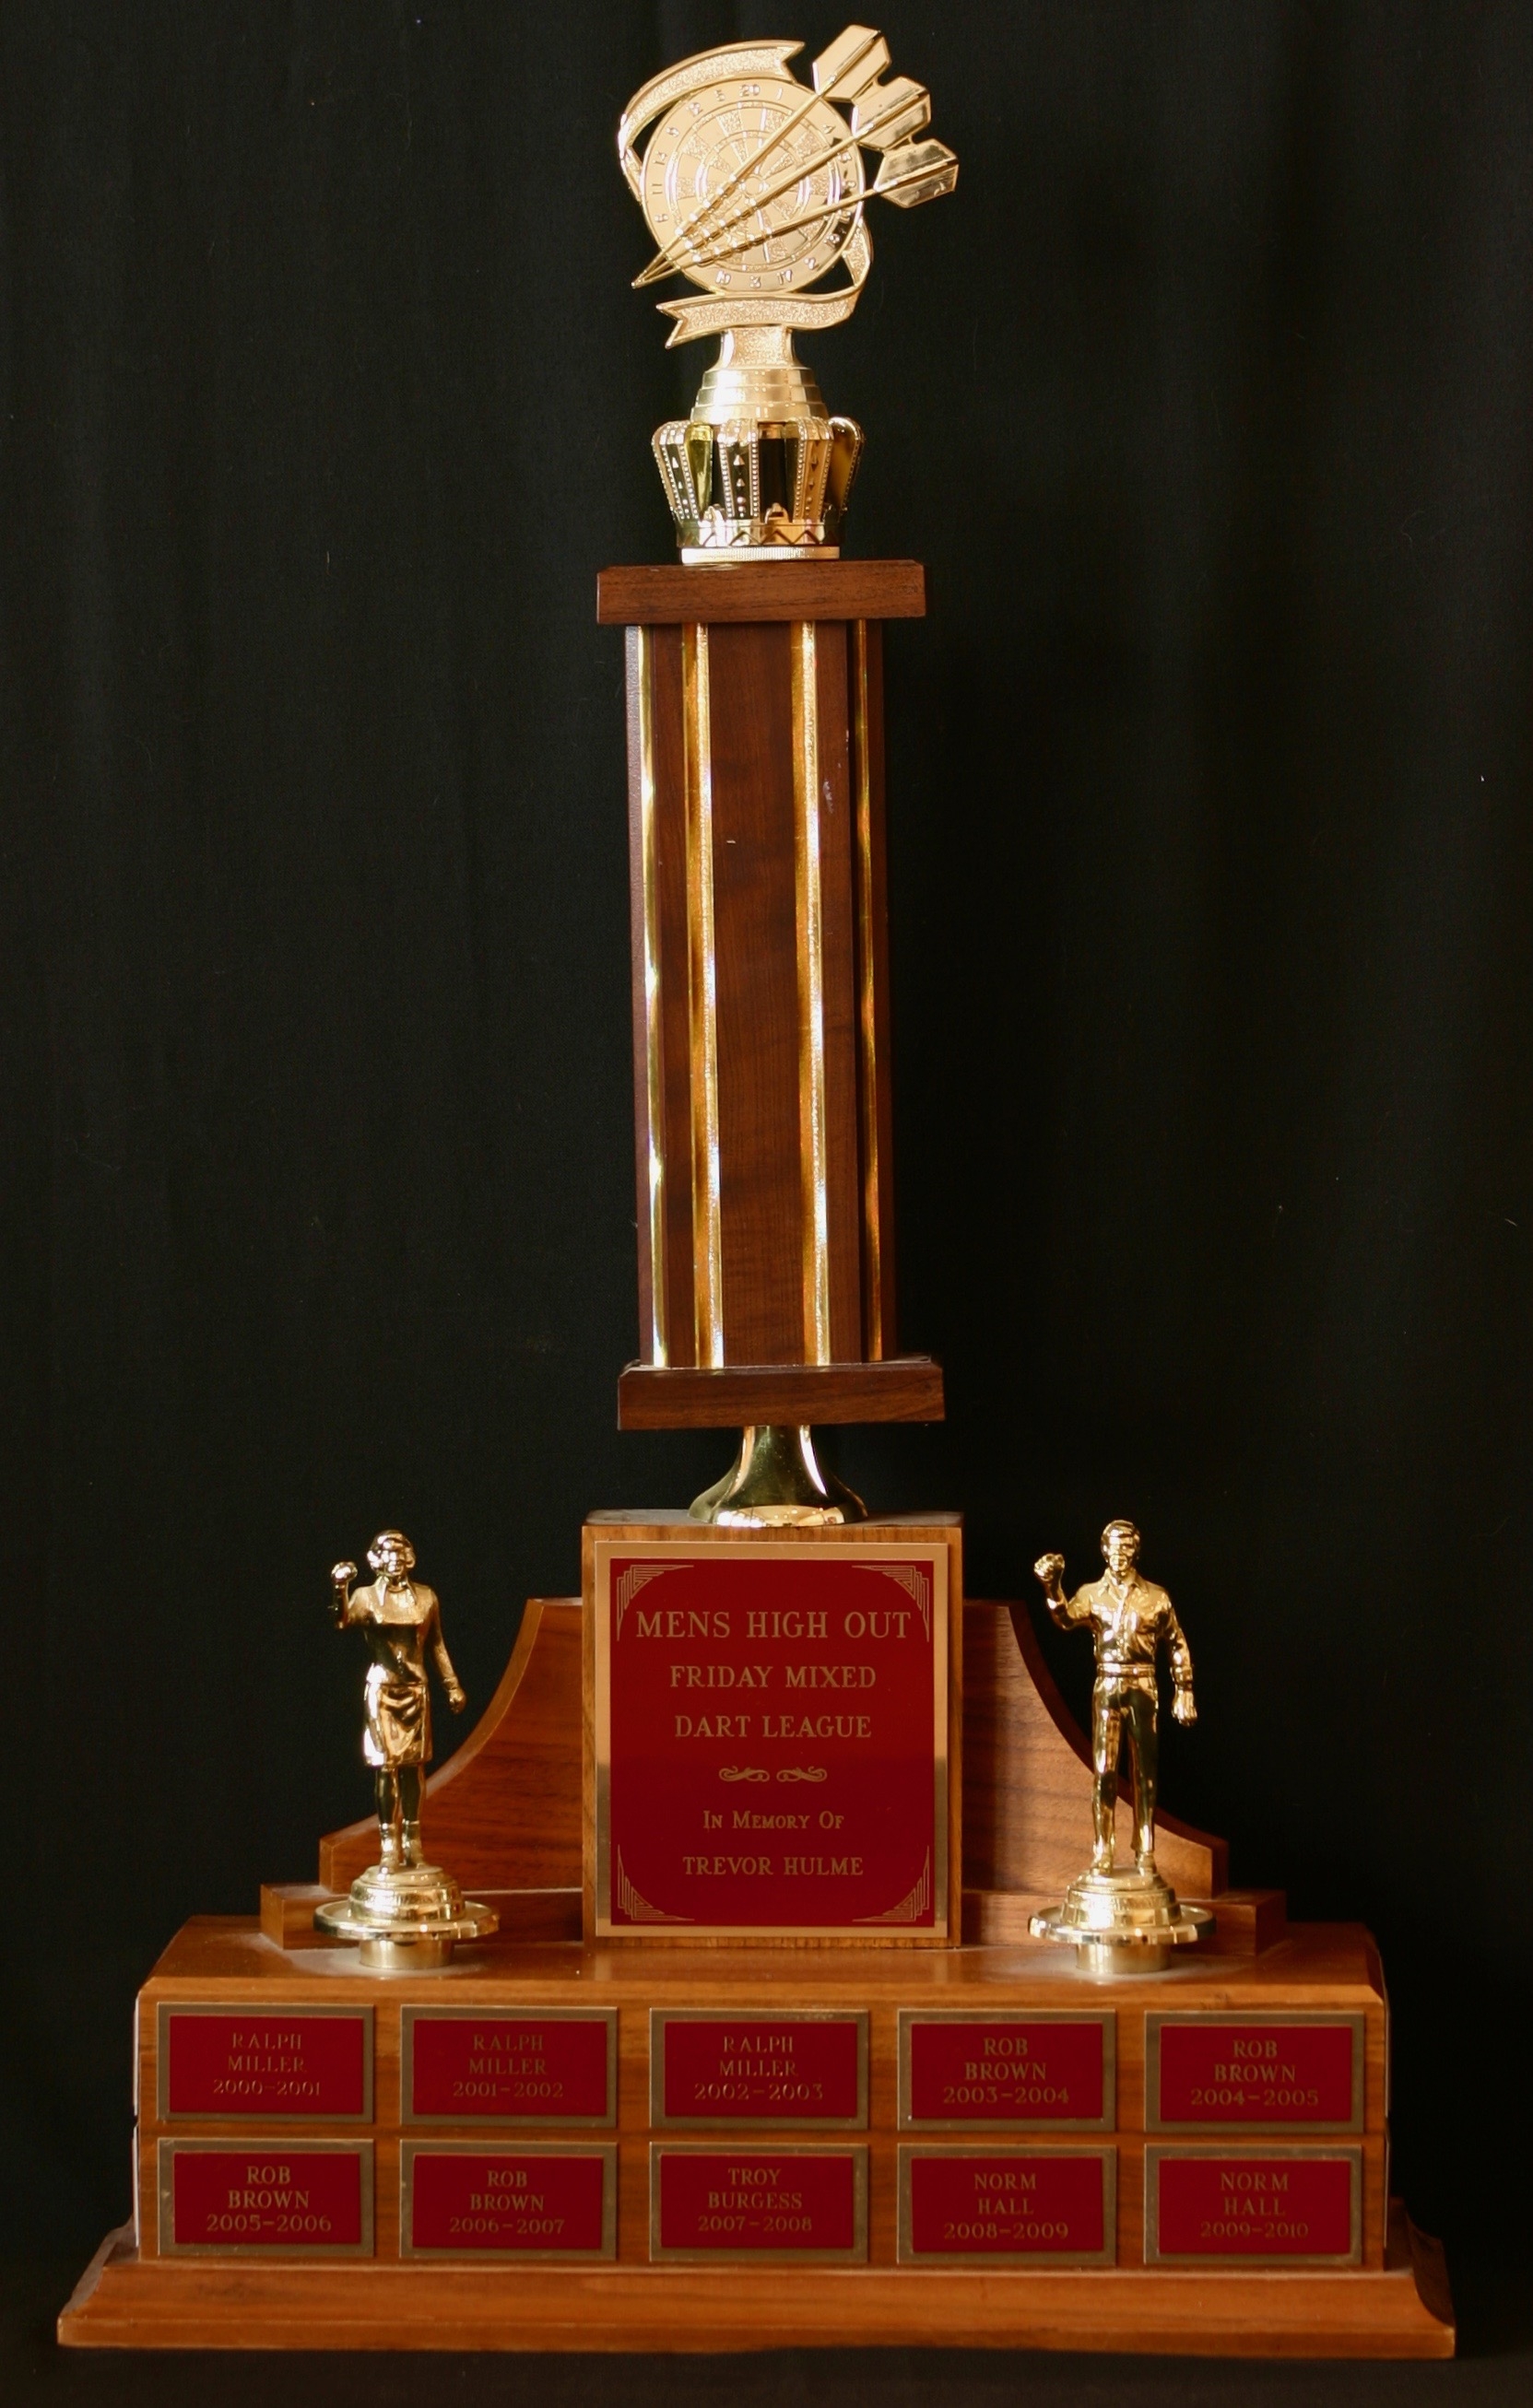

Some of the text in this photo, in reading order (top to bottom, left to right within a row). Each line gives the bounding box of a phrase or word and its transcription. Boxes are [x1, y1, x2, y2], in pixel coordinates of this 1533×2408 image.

[636, 1612, 911, 1638] MENS HIGH OUT
[670, 1666, 876, 1687] FRIDAY MIXED
[676, 1716, 871, 1737] DART LEAGUE
[683, 1857, 863, 1875] TREVOR HULME
[233, 2033, 301, 2050] RALPH
[474, 2035, 542, 2050] RALPH
[725, 2037, 792, 2052] RALPH
[984, 2038, 1028, 2055] ROB
[1234, 2040, 1277, 2058] ROB
[229, 2056, 303, 2072] MILLER
[469, 2058, 546, 2074] MILLER
[720, 2061, 795, 2076] MILLER
[965, 2062, 1045, 2080] BROWN
[1215, 2064, 1294, 2082] BROWN
[214, 2080, 319, 2095] 2000-2001
[454, 2082, 562, 2097] 2001-2002
[695, 2084, 822, 2099] 2002-2003
[944, 2086, 1068, 2103] 2003-2004
[1192, 2089, 1318, 2106] 2004-2005
[247, 2167, 290, 2184] ROB
[488, 2170, 526, 2187] ROB
[728, 2168, 780, 2185] TROY
[974, 2173, 1035, 2190] NORM
[1221, 2172, 1288, 2191] NORM
[229, 2191, 308, 2208] BROWN
[471, 2194, 543, 2211] BROWN
[709, 2191, 802, 2209] BURGESS
[979, 2198, 1033, 2214] HALL
[1224, 2197, 1285, 2215] HALL
[207, 2214, 331, 2231] 2005-2006
[450, 2217, 564, 2234] 2006-2007
[699, 2215, 811, 2231] 2007-2008
[945, 2223, 1068, 2238] 2008-2009
[1201, 2222, 1308, 2238] 2009-2010
